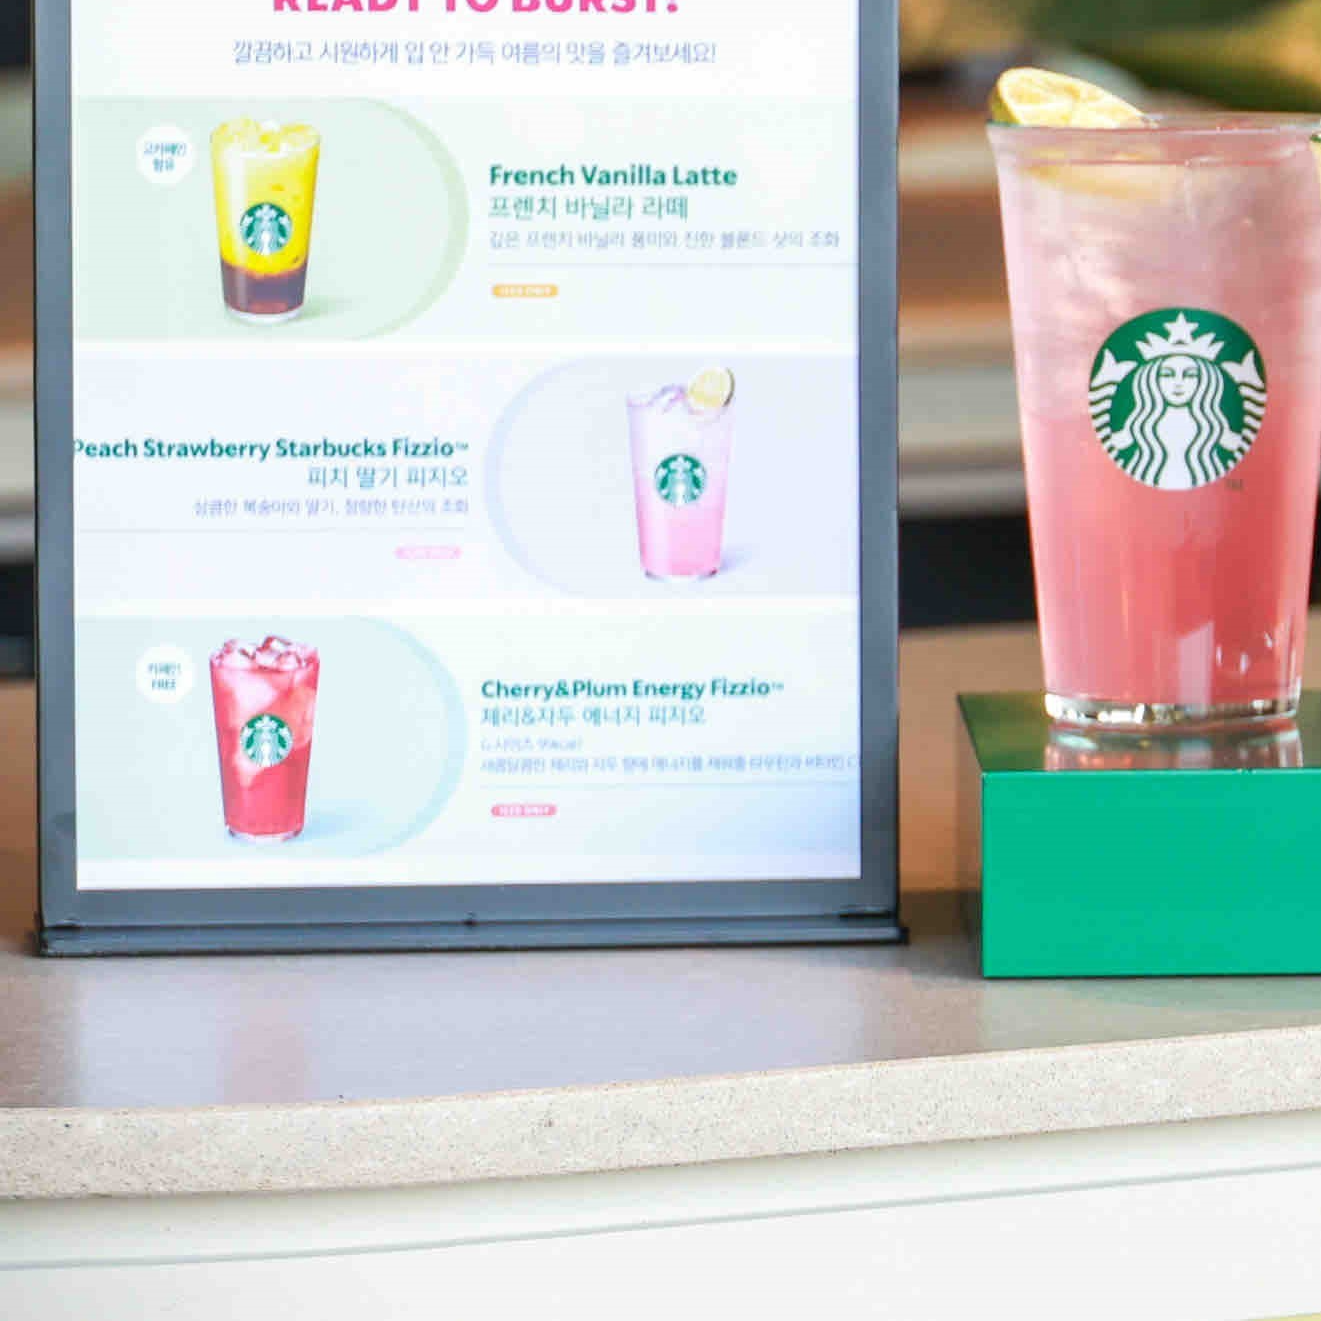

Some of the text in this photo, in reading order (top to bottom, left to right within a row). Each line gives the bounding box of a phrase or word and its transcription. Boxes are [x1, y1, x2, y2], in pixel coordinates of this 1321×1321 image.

[233, 39, 717, 64] 깔끔하고 시원하게 입 안 가득 여름의 맛을 즐겨보세요!
[489, 163, 738, 186] French Vanilla Latte
[489, 196, 688, 222] 프렌치 바닐라 라떼
[73, 438, 137, 458] Peach
[143, 437, 270, 462] Strawberry
[276, 437, 387, 458] Starbucks
[307, 466, 468, 488] 피치 딸기 피지오
[481, 679, 627, 701] Cherry&Plum
[633, 680, 705, 700] Energy
[481, 705, 705, 726] 체리&자두 에너지 피지오
